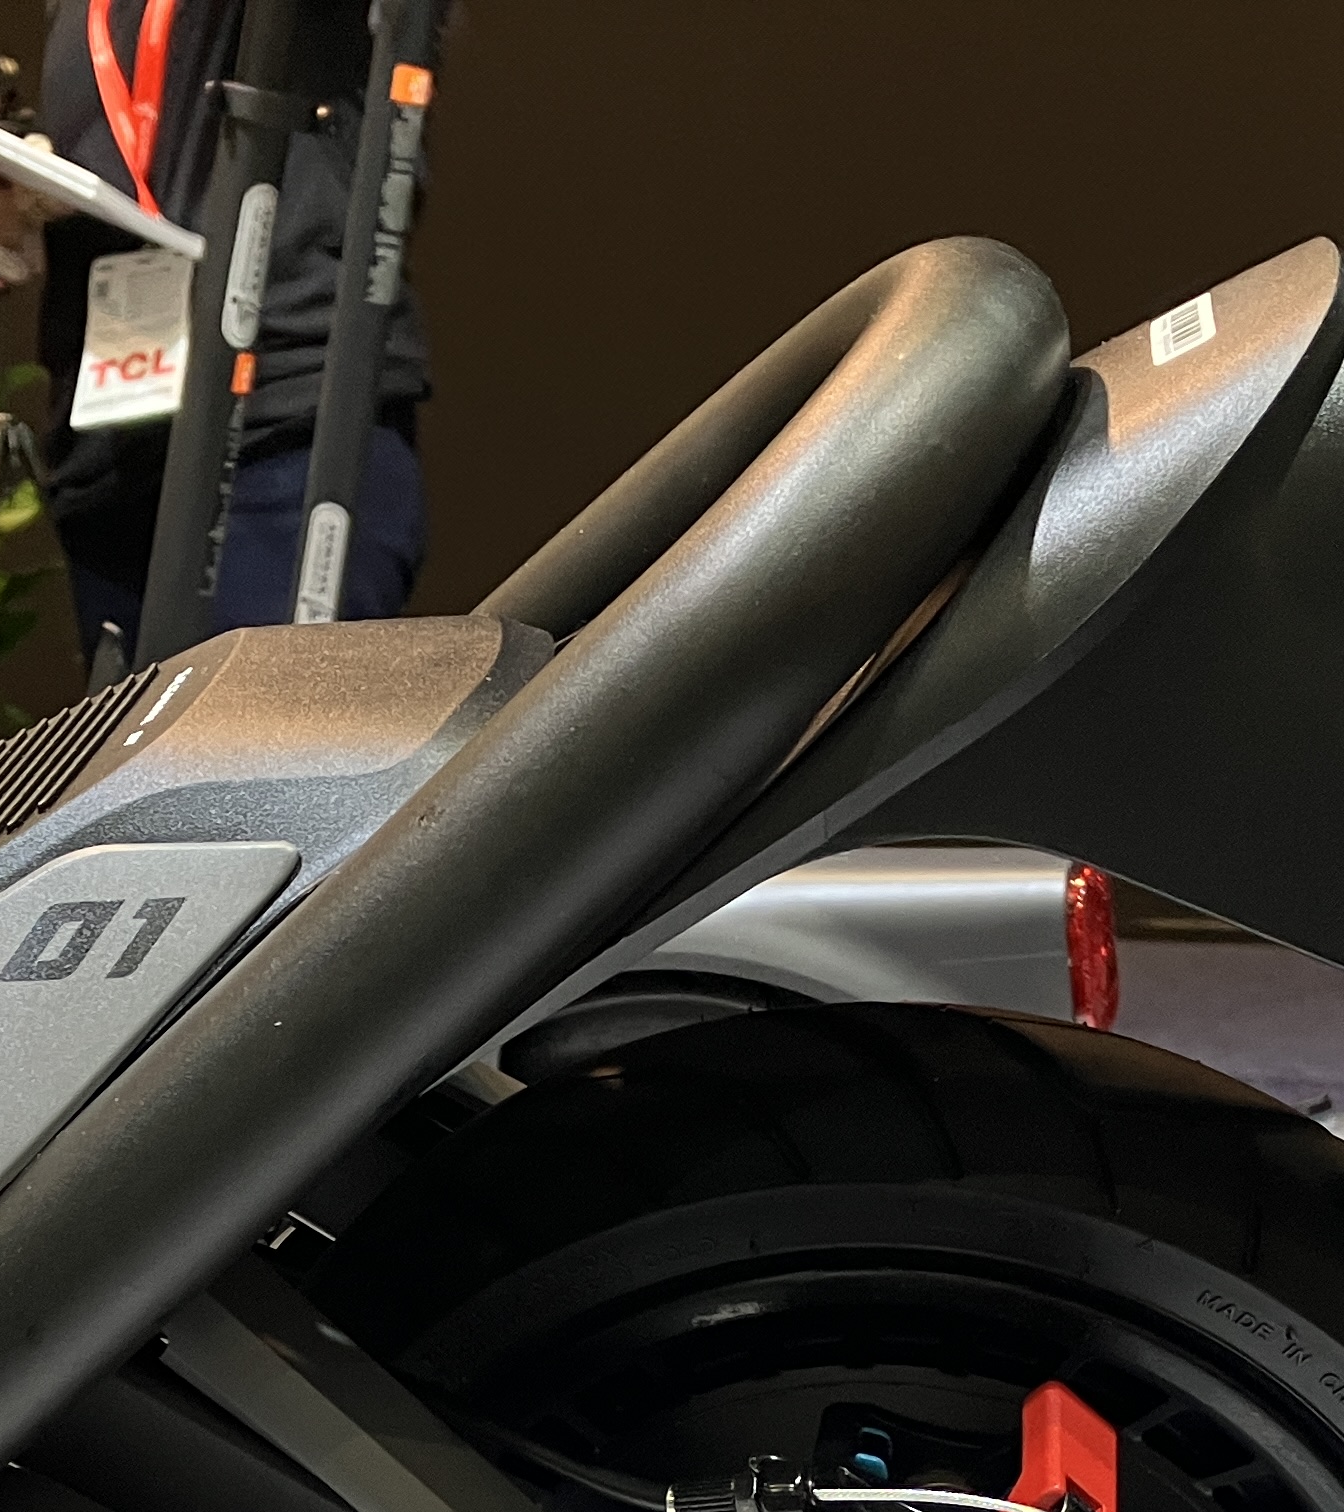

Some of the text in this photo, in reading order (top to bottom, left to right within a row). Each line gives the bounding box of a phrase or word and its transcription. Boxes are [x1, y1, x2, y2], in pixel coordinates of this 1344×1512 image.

[89, 347, 176, 389] TCL
[1197, 1288, 1277, 1342] MADE
[1280, 1337, 1311, 1367] IN
